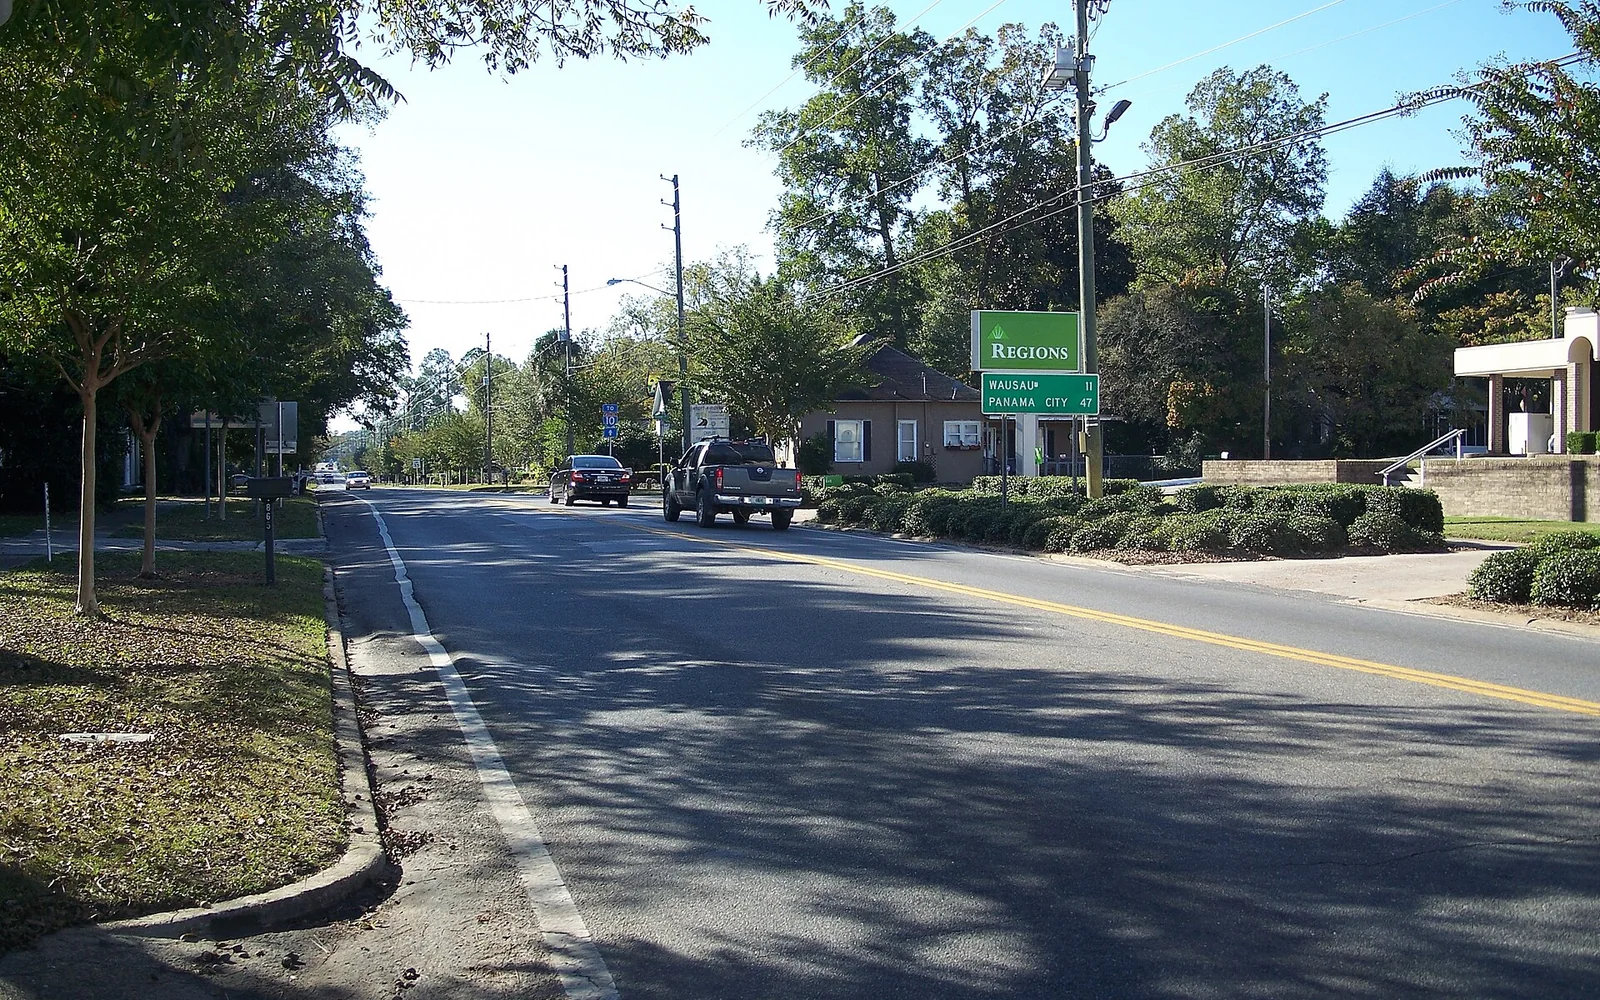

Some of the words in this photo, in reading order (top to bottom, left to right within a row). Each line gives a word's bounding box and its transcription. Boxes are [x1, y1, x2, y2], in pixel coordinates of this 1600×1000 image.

[991, 342, 1068, 360] REGIONS
[989, 380, 1034, 391] WAUSAU
[1085, 381, 1093, 391] 11
[988, 397, 1035, 407] PANAMA
[1045, 397, 1068, 408] CITY
[1080, 398, 1093, 408] 47
[605, 416, 615, 425] 10
